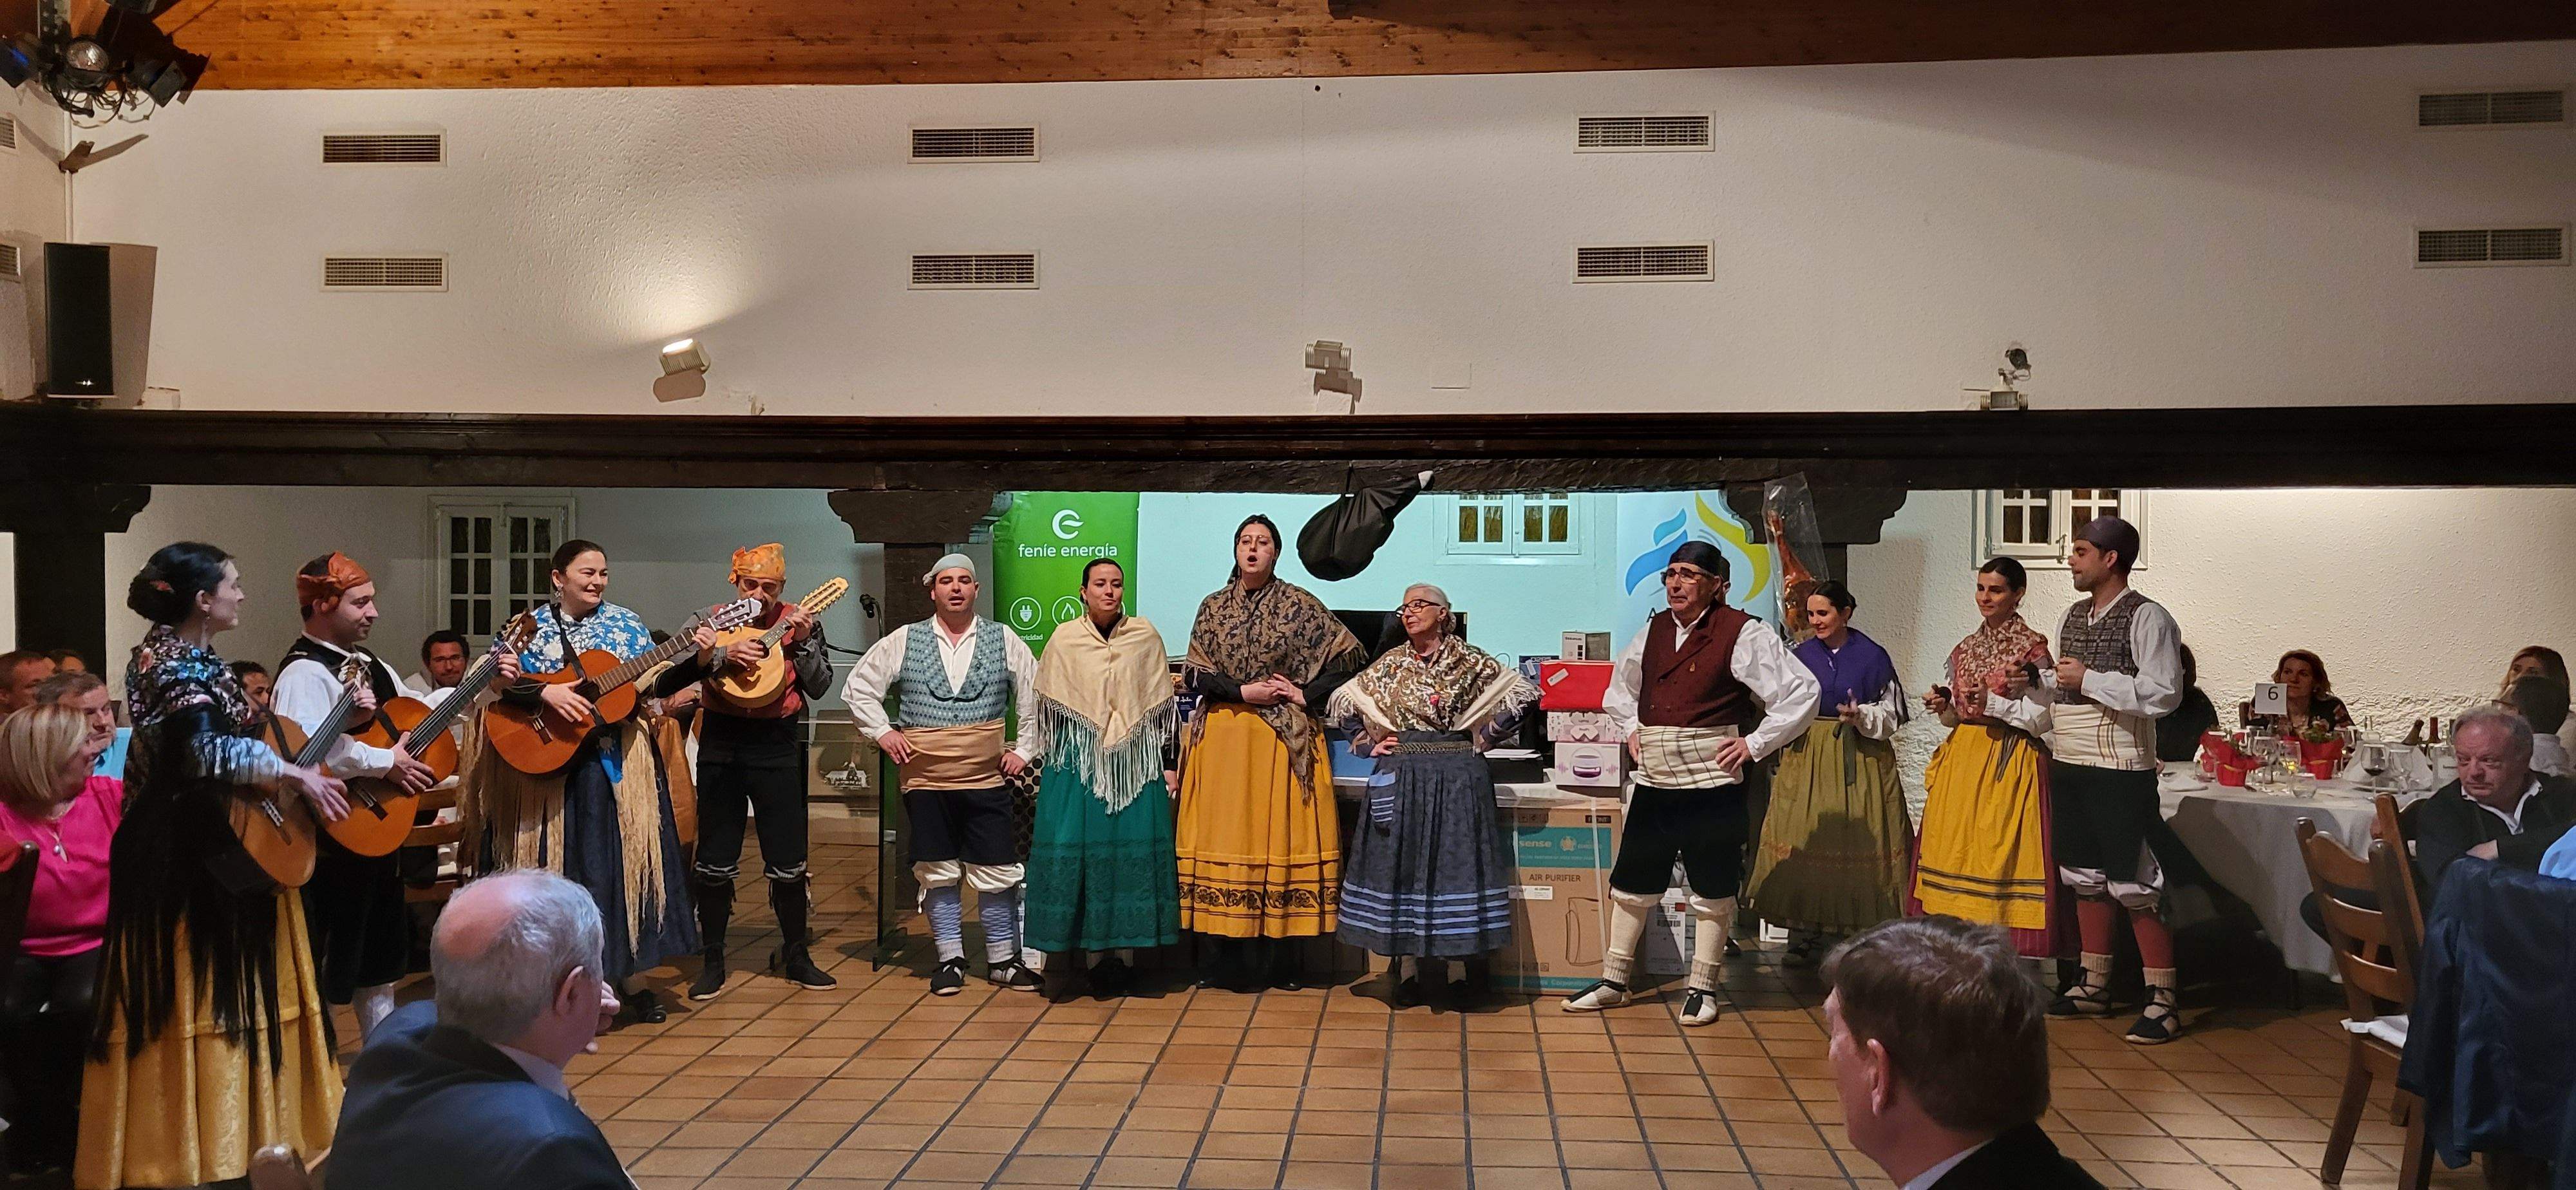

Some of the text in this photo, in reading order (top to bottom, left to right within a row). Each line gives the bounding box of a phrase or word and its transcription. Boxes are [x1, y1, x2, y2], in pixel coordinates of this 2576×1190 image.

[1018, 543, 1117, 560] feníe energía
[2268, 686, 2278, 701] 6
[1518, 840, 1553, 848] sense
[1529, 874, 1582, 883] AIR PURIFIER
